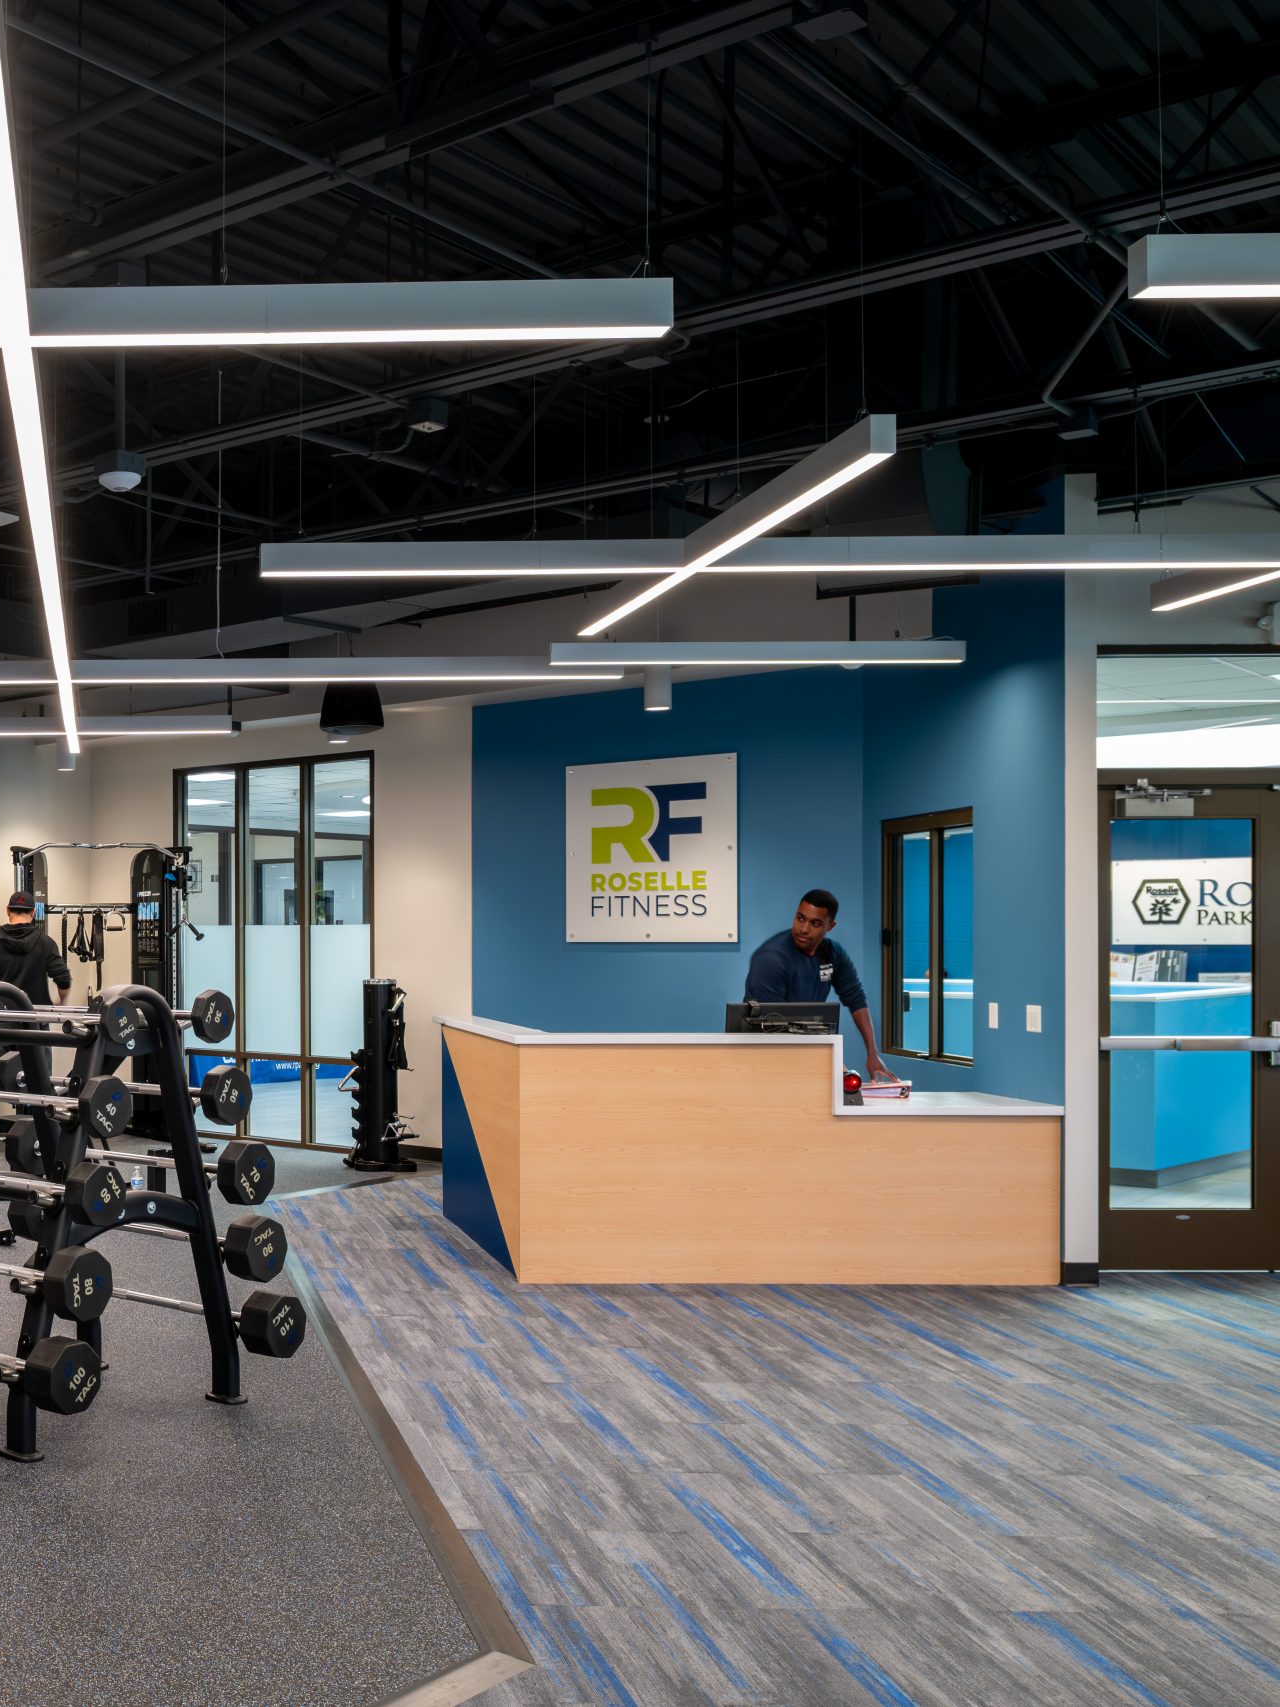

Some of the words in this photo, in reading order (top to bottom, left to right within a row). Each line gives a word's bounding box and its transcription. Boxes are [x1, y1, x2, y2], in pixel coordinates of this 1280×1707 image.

[592, 782, 706, 864] RF
[592, 870, 707, 892] ROSELLE
[592, 894, 707, 918] FITNESS
[1196, 910, 1252, 925] PARK
[118, 1016, 128, 1027] 20
[205, 1001, 215, 1024] TAG
[214, 1010, 222, 1023] 30
[119, 1024, 135, 1038] TAG
[220, 1078, 232, 1103] TAG
[230, 1088, 238, 1103] 50
[106, 1103, 116, 1116] 40
[96, 1109, 113, 1133] TAG
[250, 1166, 260, 1183] 70
[100, 1187, 111, 1204] 60
[107, 1172, 122, 1199] TAG
[240, 1173, 255, 1199] TAG
[254, 1227, 275, 1245] TAG
[262, 1243, 273, 1257] 90
[72, 1273, 81, 1308] TAG
[84, 1277, 93, 1295] 80
[272, 1304, 291, 1326] TAG
[280, 1317, 294, 1336] 110
[70, 1367, 86, 1390] 100
[75, 1374, 97, 1403] TAG
